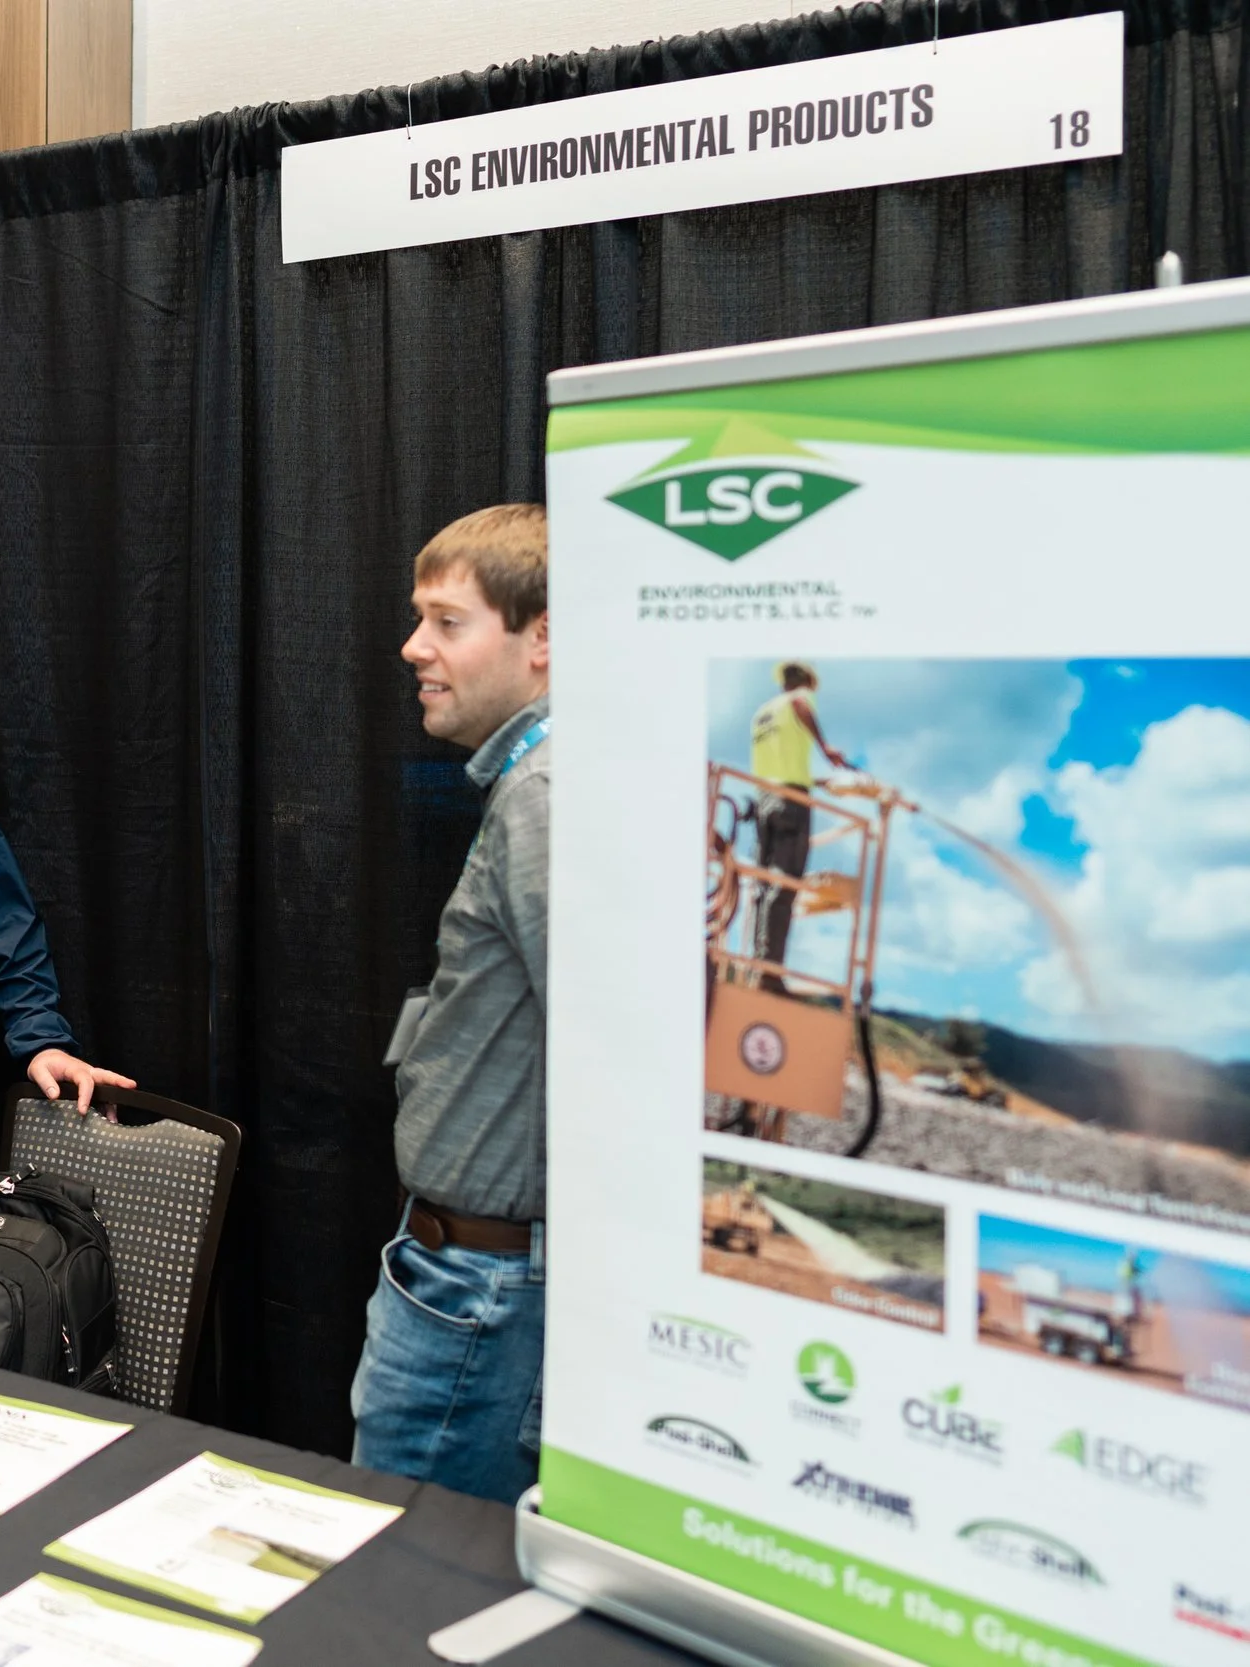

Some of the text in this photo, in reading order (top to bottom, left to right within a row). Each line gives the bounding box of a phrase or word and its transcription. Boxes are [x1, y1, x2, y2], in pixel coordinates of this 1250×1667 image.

[409, 84, 934, 200] LSC ENVIRONMENTAL PRODUCTS
[1050, 110, 1091, 149] 18
[663, 471, 803, 527] LSC
[639, 580, 841, 602] ENVIRONMENTAL
[649, 1319, 751, 1371] MESIC
[1094, 1437, 1212, 1502] EDGE
[682, 1507, 835, 1589] Solutions
[841, 1564, 893, 1609] for
[903, 1589, 964, 1636] the
